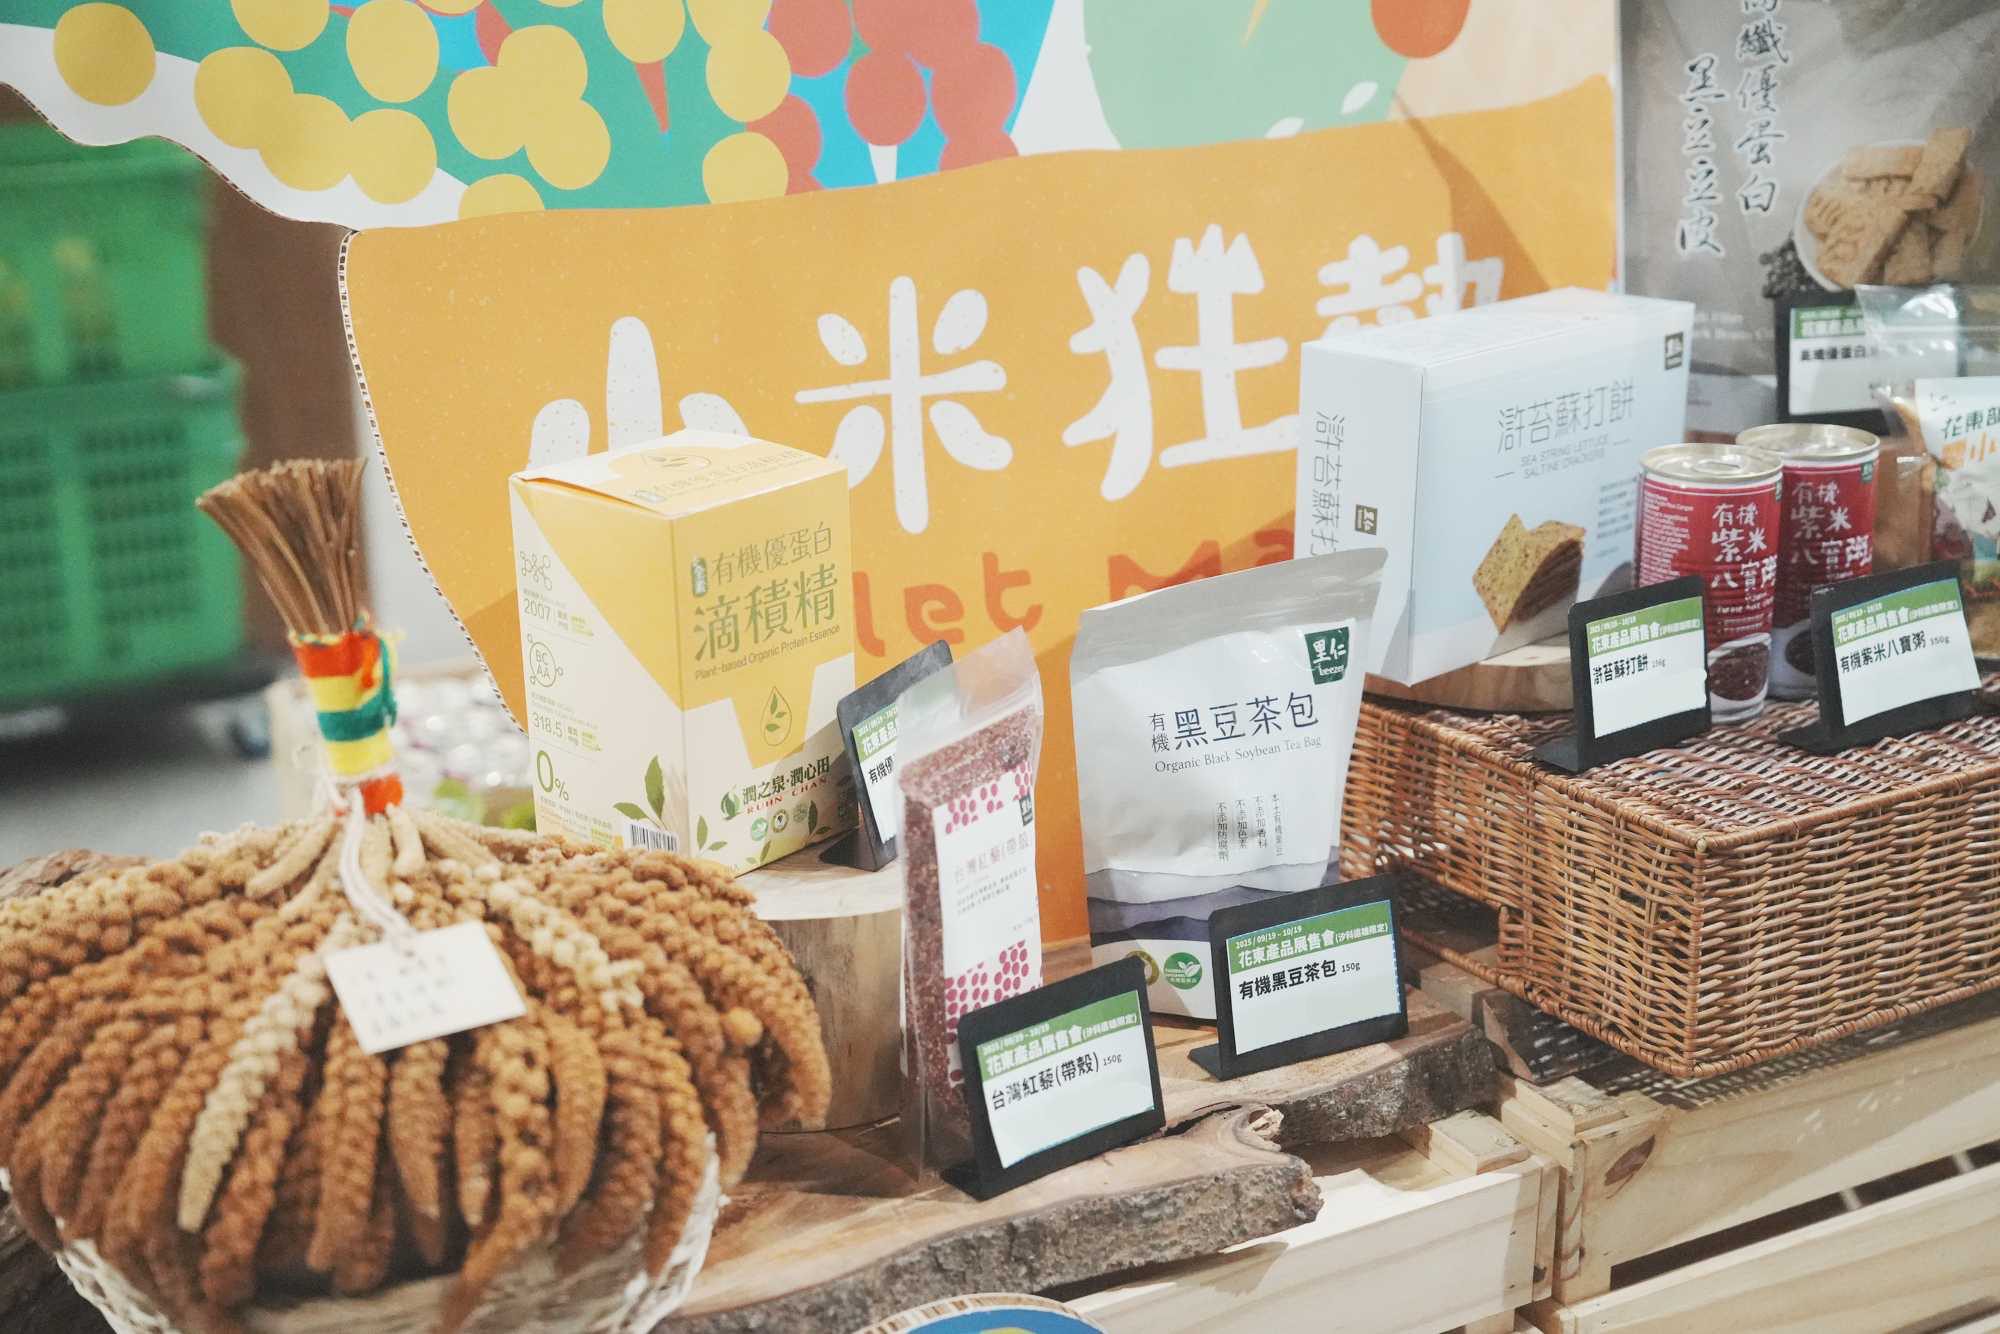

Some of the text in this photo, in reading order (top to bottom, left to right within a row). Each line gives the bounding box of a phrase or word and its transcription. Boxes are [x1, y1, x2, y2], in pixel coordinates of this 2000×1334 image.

[1712, 502, 1758, 527] 有機
[712, 521, 832, 585] 有機優蛋白
[524, 598, 551, 623] 2007
[694, 564, 838, 662] 滴積精
[748, 645, 780, 666] Organic
[781, 635, 808, 654] Protein
[809, 624, 841, 642] Essence
[1312, 638, 1347, 666] 里仁
[1840, 630, 1927, 674] 有機紫米八寶粥
[532, 712, 563, 738] 318.5
[1149, 712, 1170, 753] 有機
[1174, 691, 1319, 751] 黑豆茶包
[1154, 758, 1201, 774] Organic
[1204, 752, 1231, 767] Black
[1235, 743, 1281, 760] Soybean
[1303, 736, 1322, 748] Bag
[1239, 959, 1361, 1000] 有機黑豆茶包 150g
[992, 1051, 1122, 1111] 台灣紅藜(帶殼) 150g
